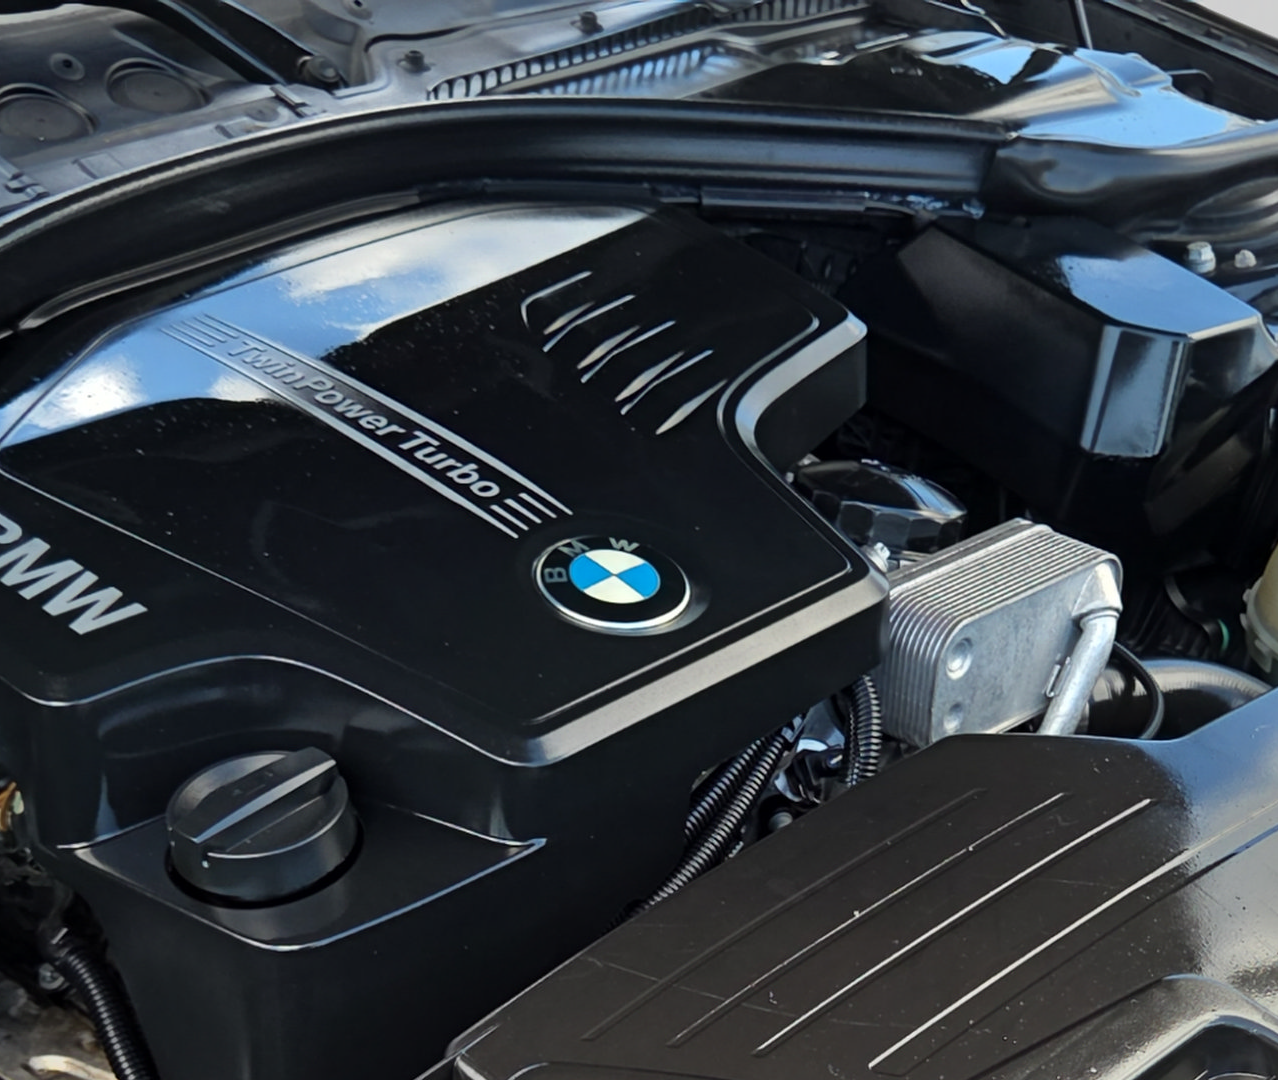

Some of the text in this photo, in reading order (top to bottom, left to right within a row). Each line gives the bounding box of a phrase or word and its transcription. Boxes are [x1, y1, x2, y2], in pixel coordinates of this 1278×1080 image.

[228, 341, 501, 498] TwinPower Turbo
[543, 536, 640, 584] BMW
